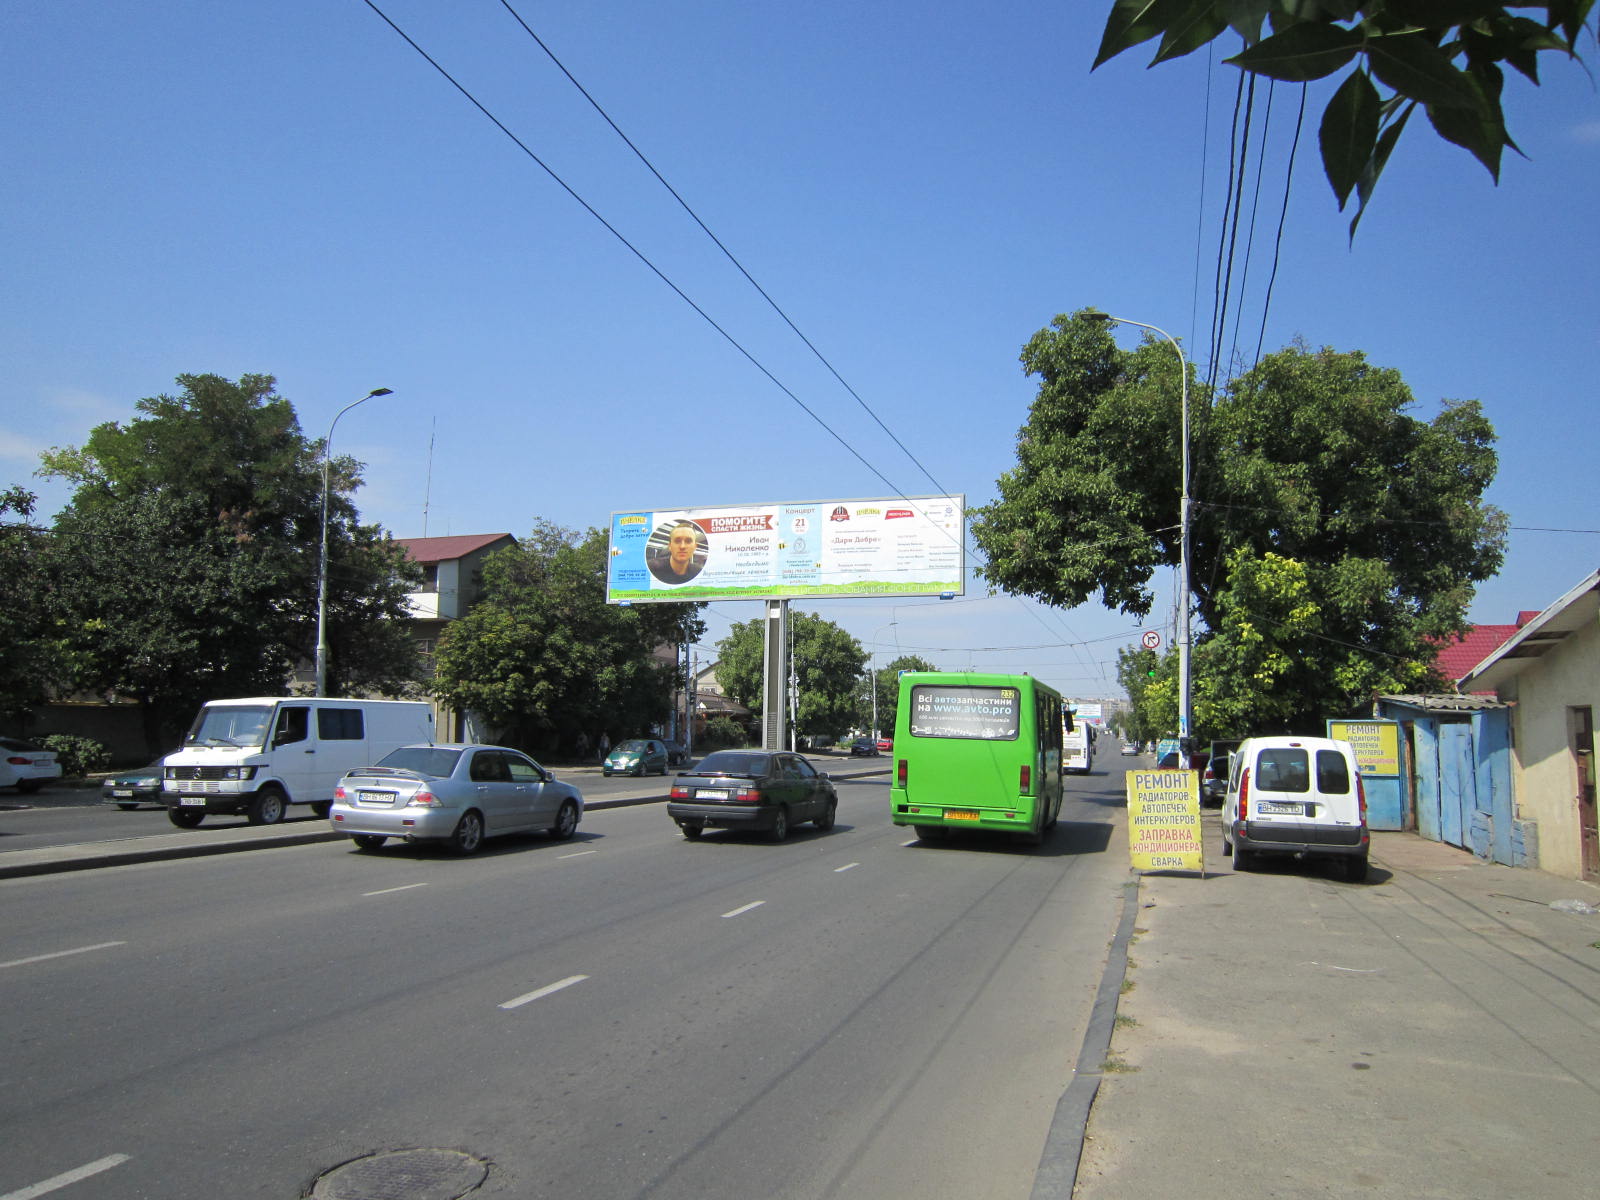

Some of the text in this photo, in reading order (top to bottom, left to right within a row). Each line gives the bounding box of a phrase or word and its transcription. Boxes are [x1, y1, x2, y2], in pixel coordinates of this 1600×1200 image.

[711, 516, 766, 526] ПОМОГИТЕ
[795, 518, 805, 527] 21
[918, 695, 1012, 705] Всі автозапчастини
[934, 704, 1011, 716] www.avto.pro
[1346, 725, 1379, 734] РЕМОНТ
[1136, 774, 1189, 789] РЕМОНТ
[1138, 792, 1189, 801] РАДИАТОРОВ
[1142, 803, 1187, 813] АВТОПЕЧЕК
[1135, 815, 1195, 825] ИНТЕРКУЛЕРОВ
[1139, 829, 1192, 840] ЗАПРАВКА
[1133, 842, 1200, 853] КОНДИЦИОНЕРА
[1152, 857, 1183, 866] СВАРКА
